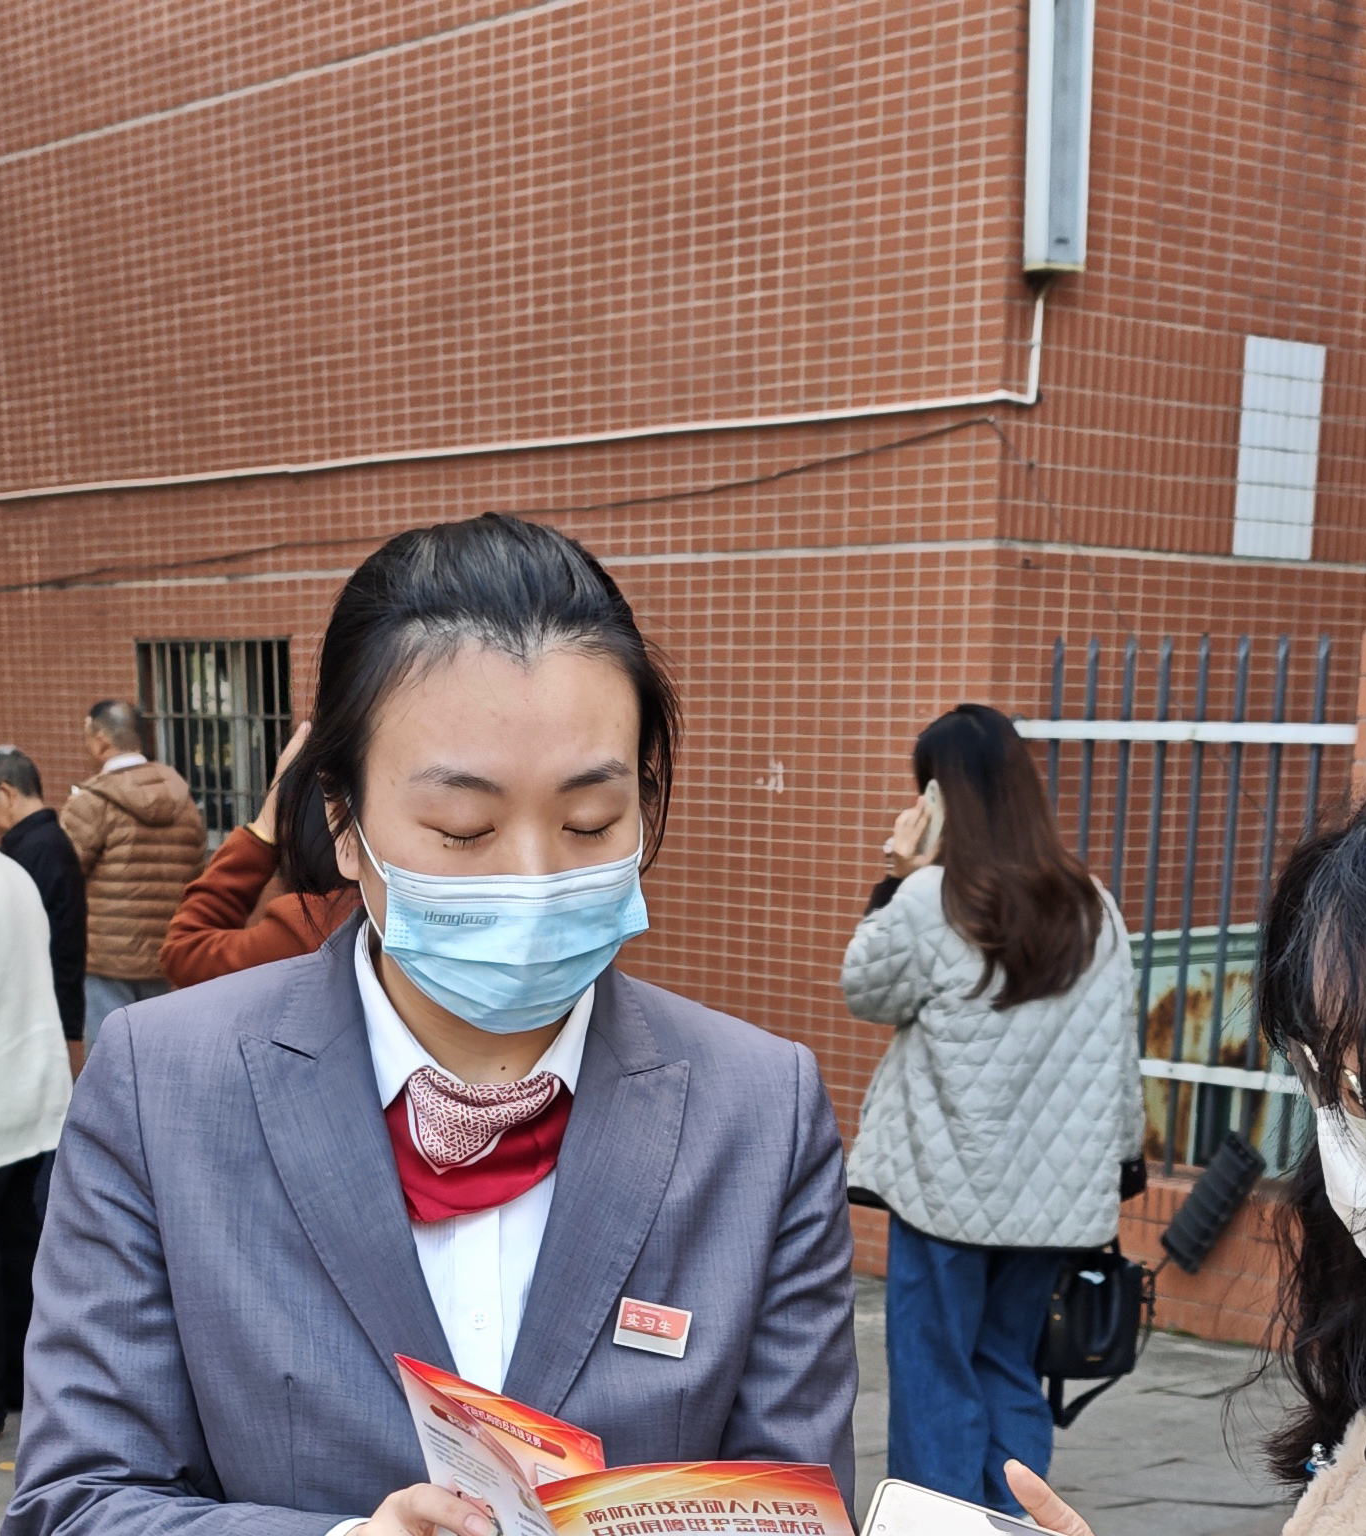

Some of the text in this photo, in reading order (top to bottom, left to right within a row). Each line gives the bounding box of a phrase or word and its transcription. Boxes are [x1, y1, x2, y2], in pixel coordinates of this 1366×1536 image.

[424, 910, 498, 926] HongGuan
[624, 1313, 672, 1335] 实习生
[583, 1500, 818, 1525] 预防洗钱活动人人有责
